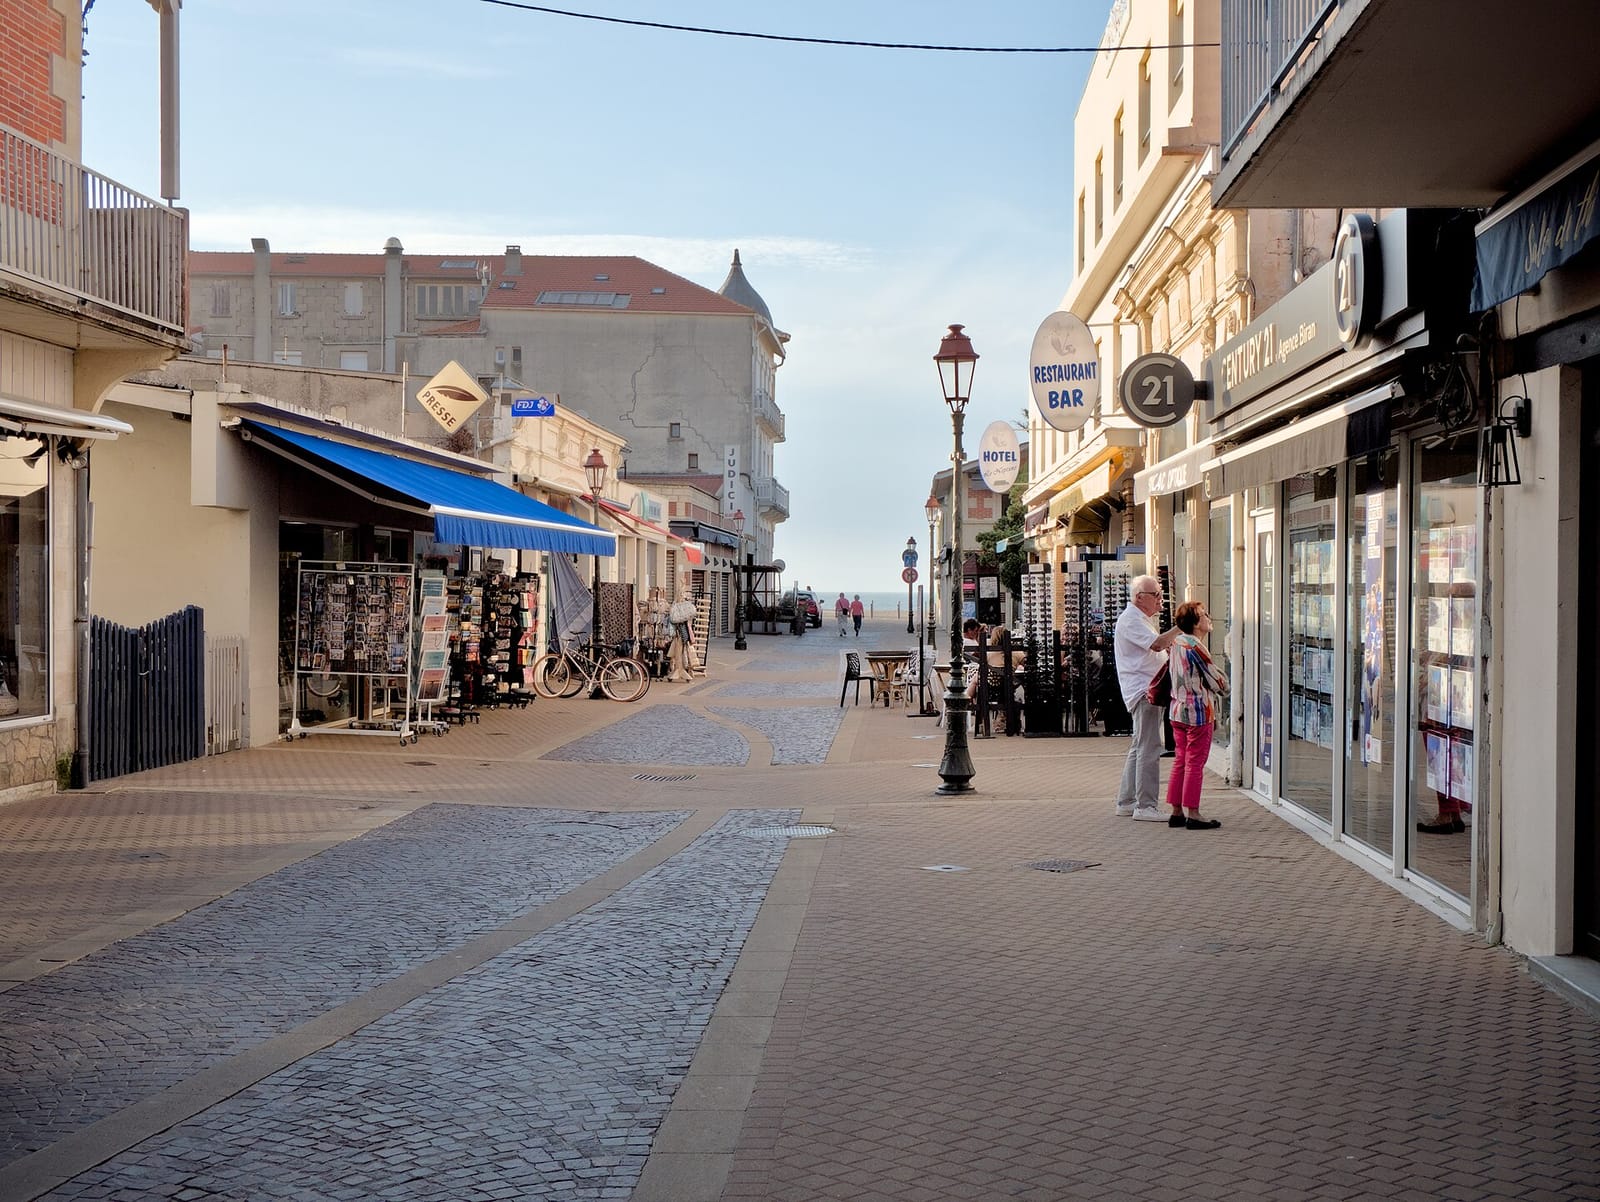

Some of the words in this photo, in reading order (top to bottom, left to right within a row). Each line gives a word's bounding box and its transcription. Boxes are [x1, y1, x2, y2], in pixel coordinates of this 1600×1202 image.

[1221, 331, 1262, 390] CENTURY
[1264, 324, 1275, 367] 21
[1278, 333, 1299, 363] Agence
[1299, 322, 1317, 346] Biran
[1034, 361, 1097, 383] RESTAURANT
[422, 391, 456, 428] PRESSE
[516, 401, 534, 409] FDJ
[1048, 388, 1084, 409] BAR
[983, 451, 1017, 462] HOTEL
[727, 448, 736, 511] JUDICI
